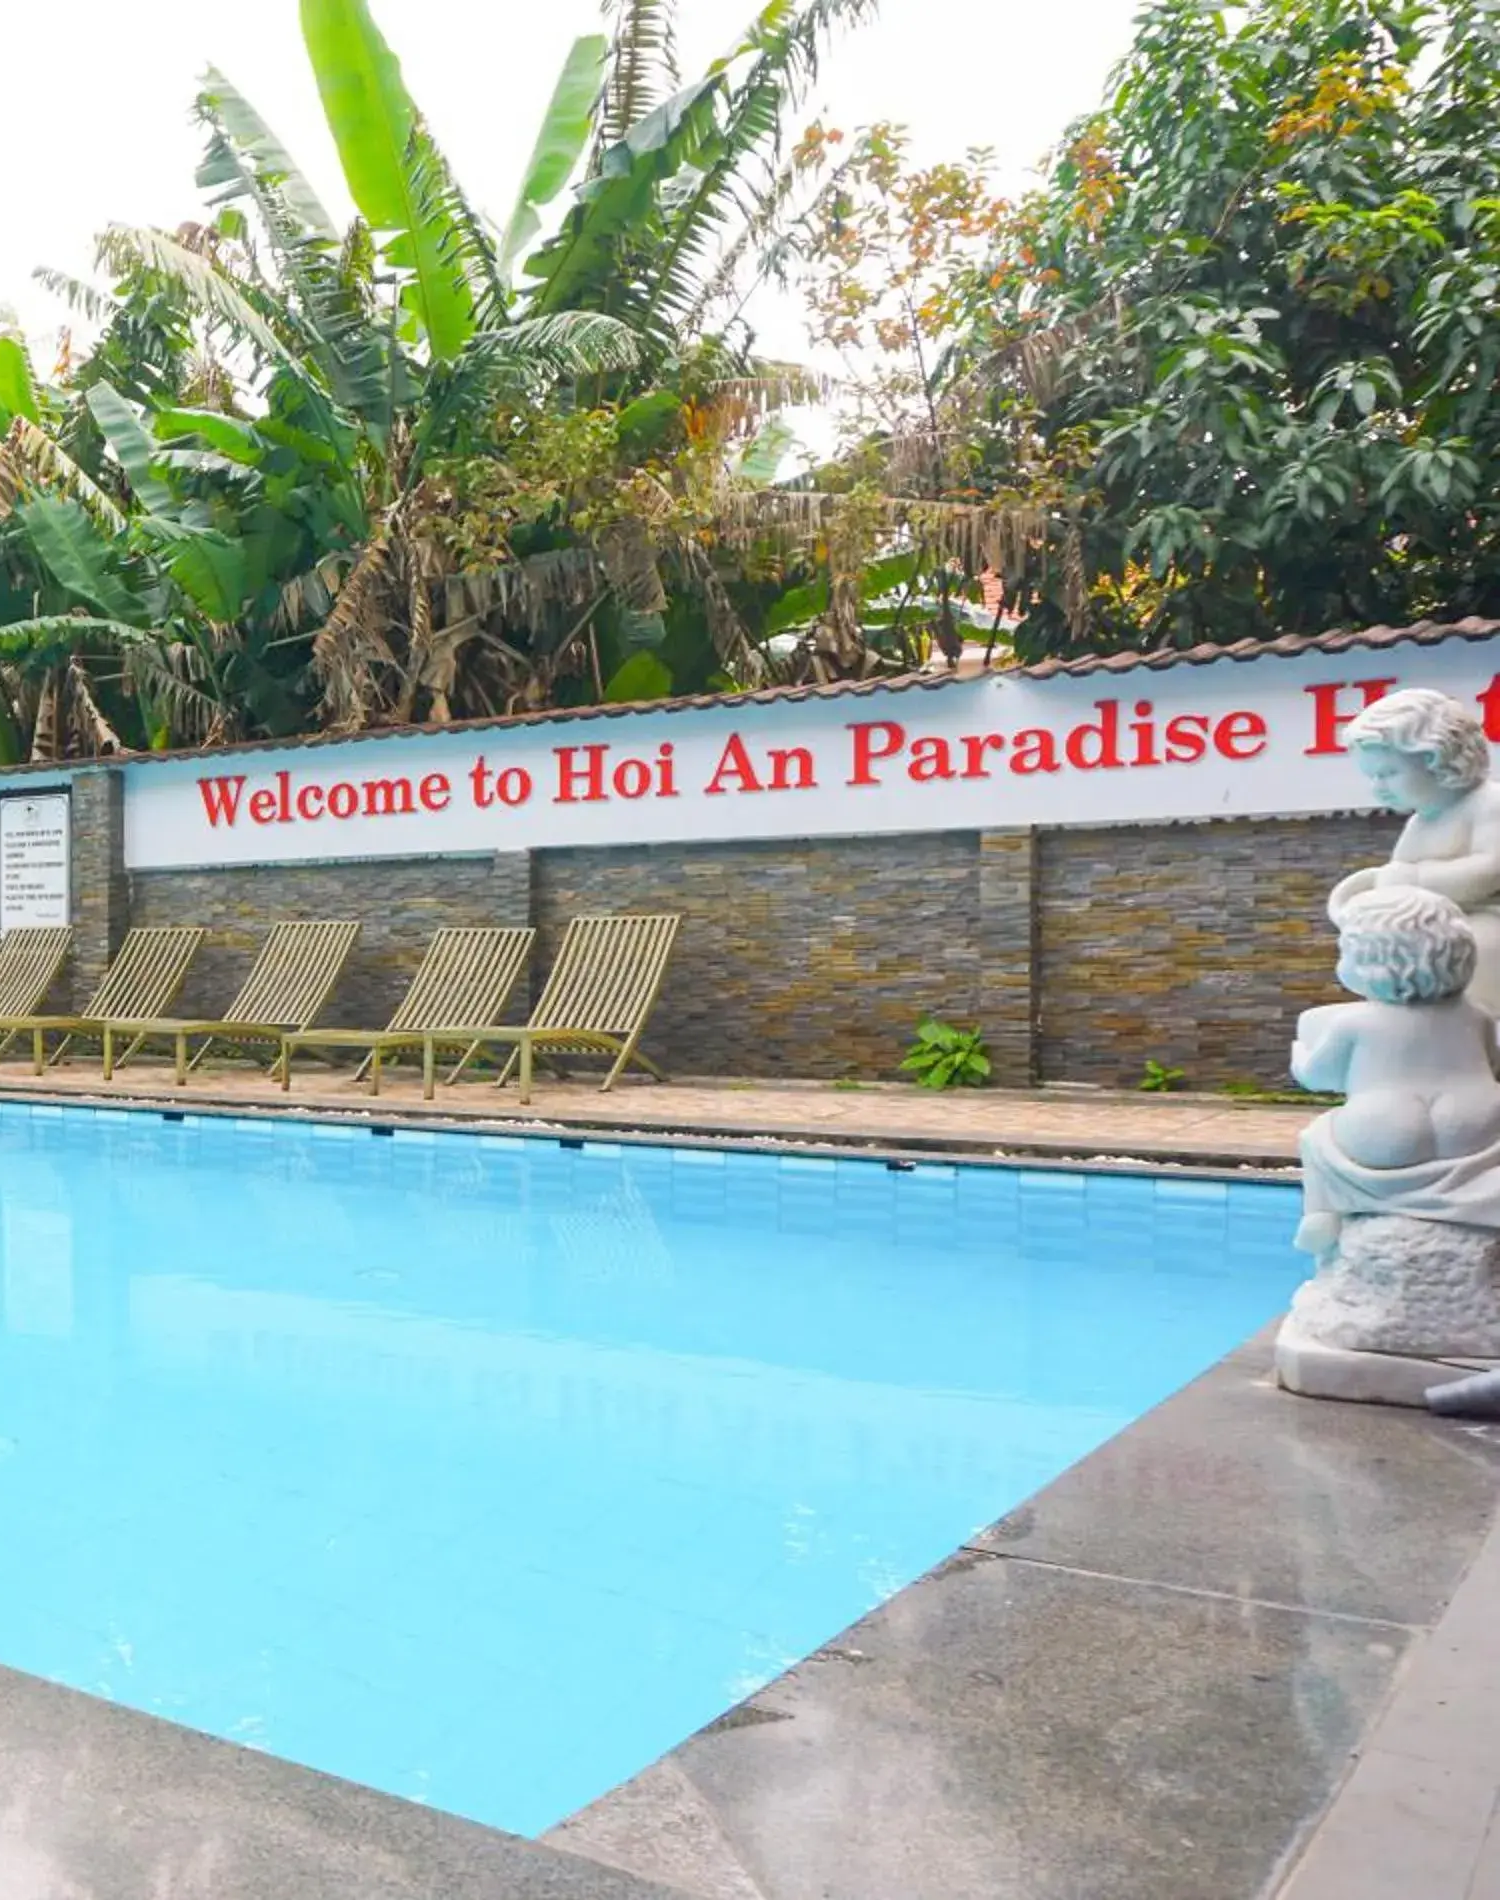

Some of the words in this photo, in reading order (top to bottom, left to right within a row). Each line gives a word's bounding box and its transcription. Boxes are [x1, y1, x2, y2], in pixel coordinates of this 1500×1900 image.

[197, 770, 451, 827] Welcome
[469, 756, 533, 808] to
[552, 743, 678, 803] Hoi
[704, 732, 818, 795] An
[845, 699, 1268, 787] Paradise
[1303, 676, 1500, 757] Ht
